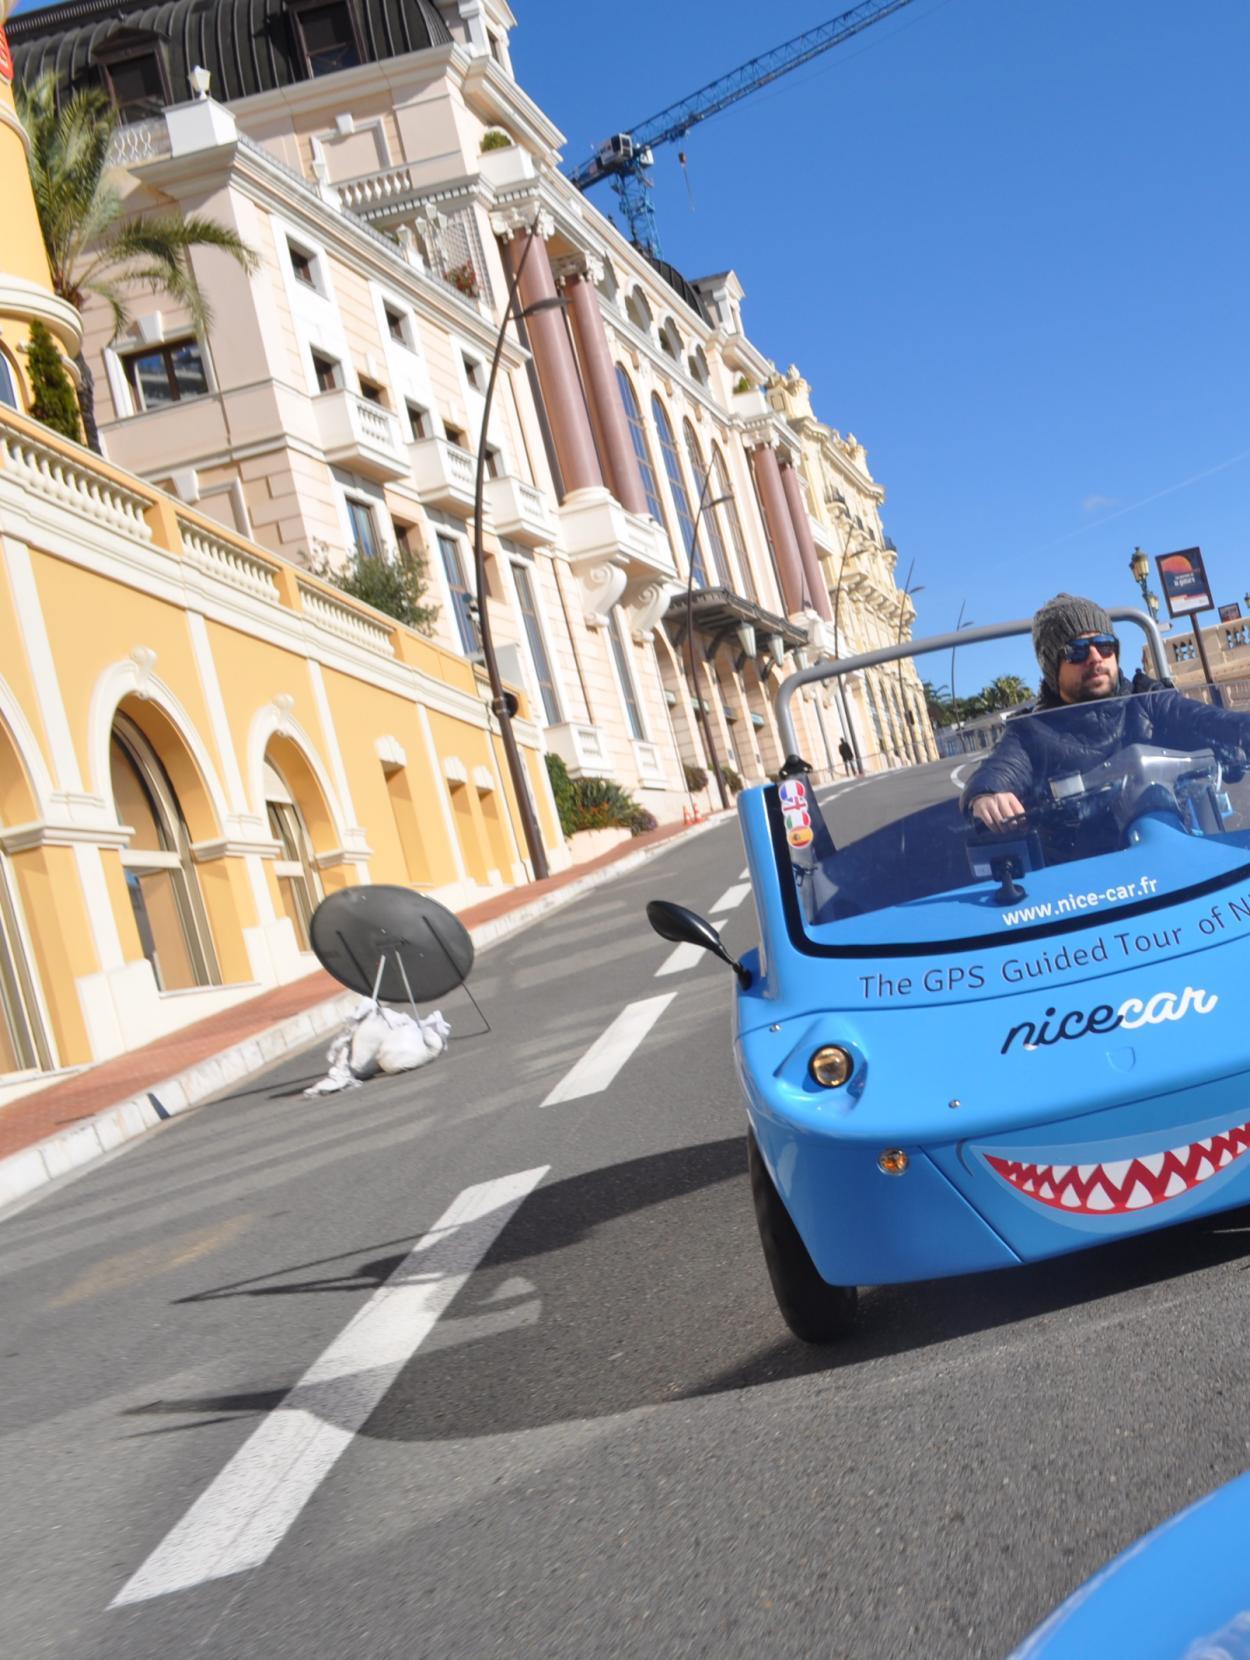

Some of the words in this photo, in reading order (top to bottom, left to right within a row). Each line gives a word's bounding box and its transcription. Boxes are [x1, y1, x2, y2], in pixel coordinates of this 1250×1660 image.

[1002, 876, 1157, 926] www.nice-car.fr
[859, 974, 912, 998] The
[924, 965, 985, 992] GPS
[1002, 937, 1109, 983] Guided
[1114, 927, 1182, 955] Tour
[1198, 905, 1225, 935] of
